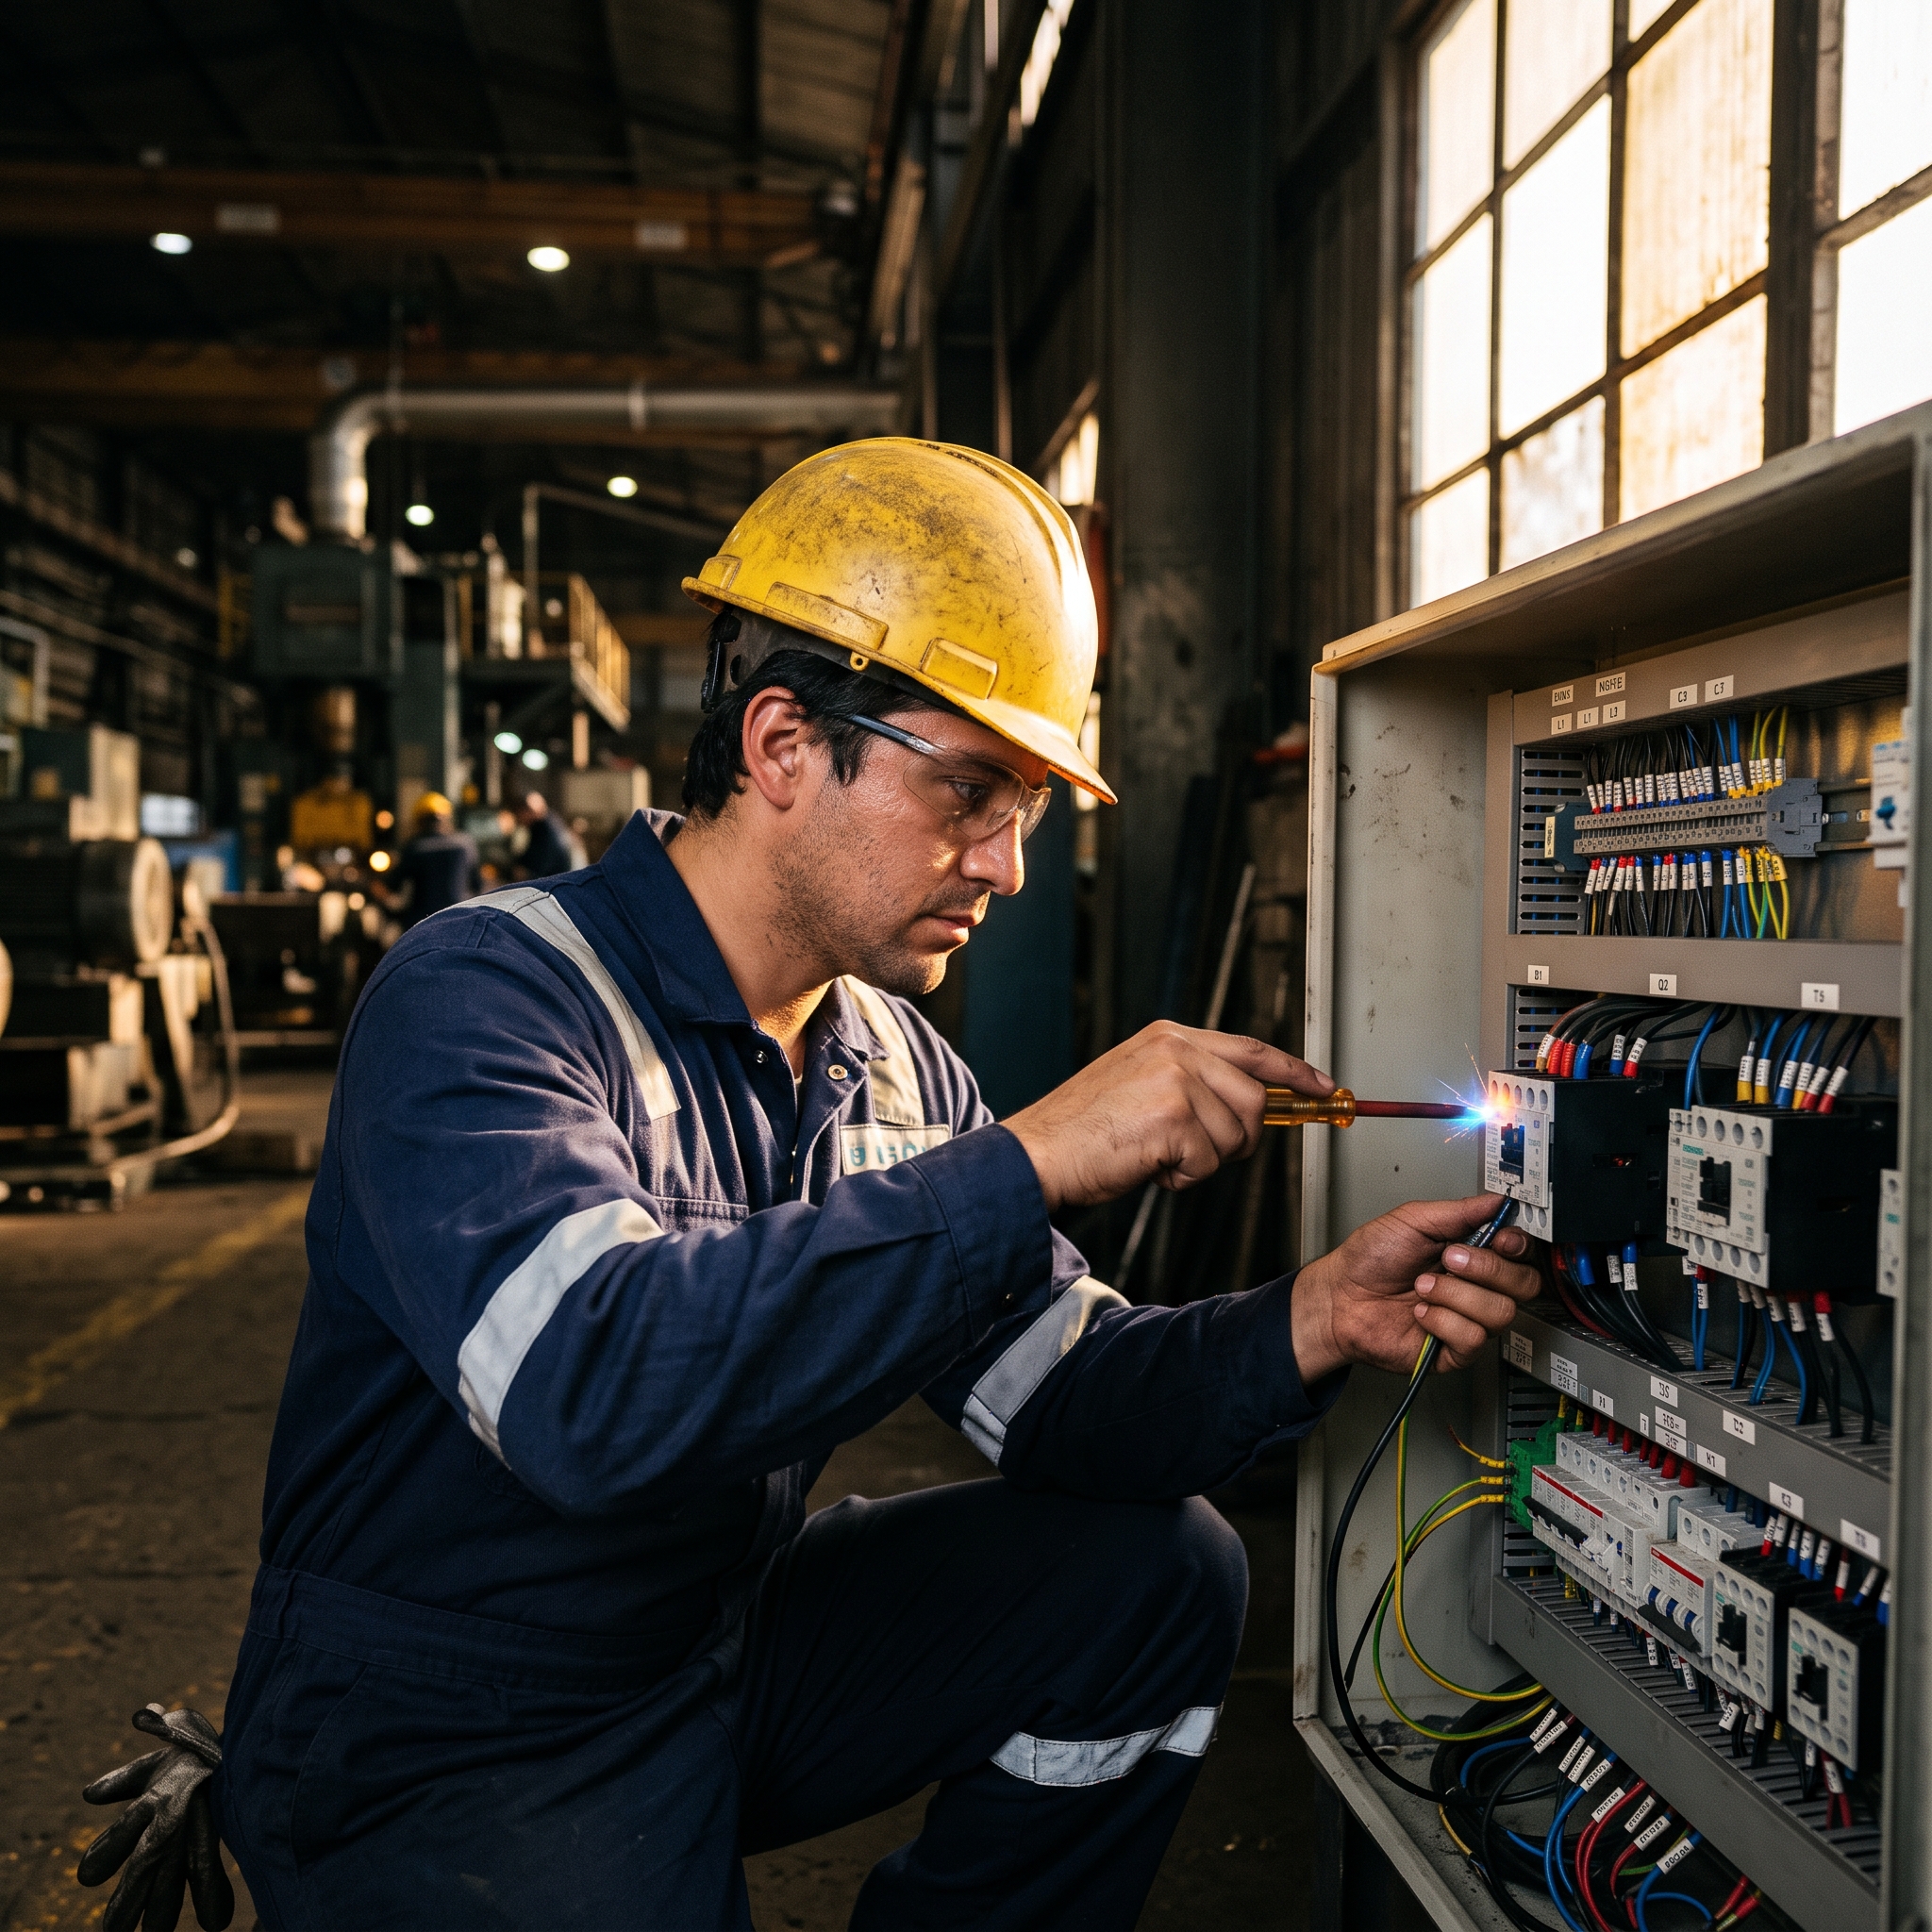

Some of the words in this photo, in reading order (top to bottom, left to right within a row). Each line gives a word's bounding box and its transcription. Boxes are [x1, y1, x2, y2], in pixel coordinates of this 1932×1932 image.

[1677, 691, 1688, 703] C3
[1657, 978, 1669, 991] Q2
[1813, 989, 1824, 1003] T5
